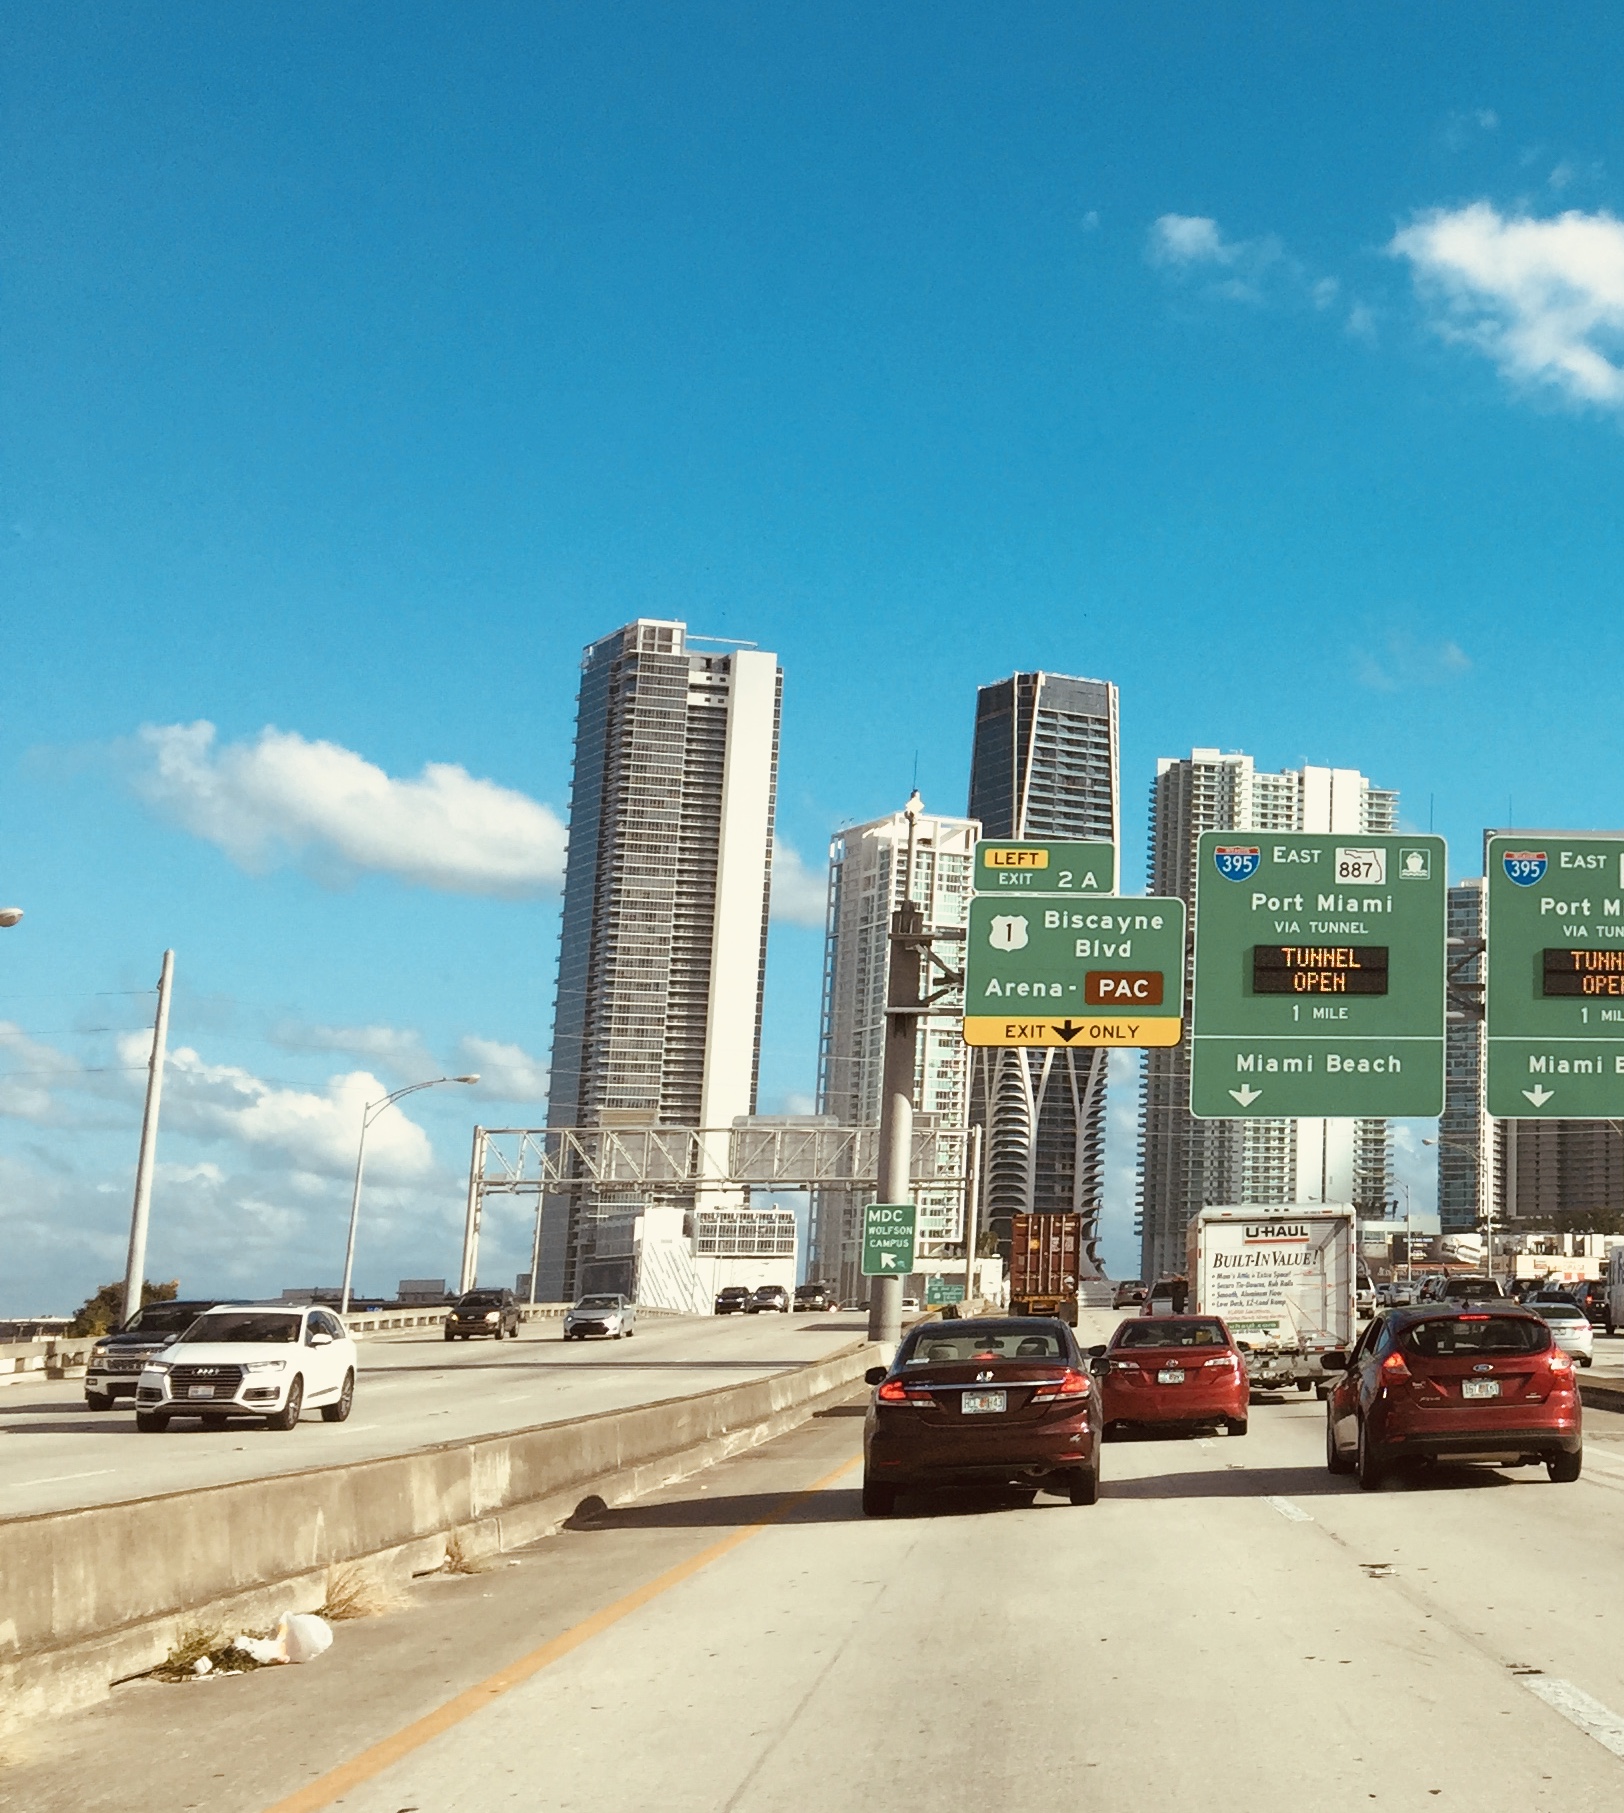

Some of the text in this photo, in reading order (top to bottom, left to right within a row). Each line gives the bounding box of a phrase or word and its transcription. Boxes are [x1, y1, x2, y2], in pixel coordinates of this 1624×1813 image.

[994, 852, 1039, 865] LEFT
[1273, 847, 1322, 863] EAST
[1560, 852, 1607, 869] EAST
[1222, 855, 1253, 873] 395
[1339, 862, 1373, 878] 887
[1511, 861, 1540, 878] 395
[999, 873, 1033, 885] EXIT
[1251, 893, 1393, 912] Port Miami
[1540, 898, 1591, 916] Port
[1044, 910, 1164, 934] Biscayne
[1274, 921, 1369, 934] VIA TUNNEL
[1006, 923, 1012, 942] 1
[1563, 925, 1588, 937] VIA
[1075, 939, 1131, 958] Blvd
[1281, 947, 1361, 968] TUNNEL
[1099, 979, 1149, 998] PAC
[1294, 972, 1346, 992] OPEN
[1293, 1005, 1349, 1021] 1 MILE
[1581, 1007, 1588, 1023] 1
[1006, 1025, 1140, 1039] EXIT ONLY
[1236, 1054, 1402, 1073] Miami Beach
[1529, 1055, 1603, 1074] Miami
[868, 1210, 903, 1222] MDC
[868, 1226, 913, 1236] WOLFSON
[869, 1239, 910, 1248] CAMPUS
